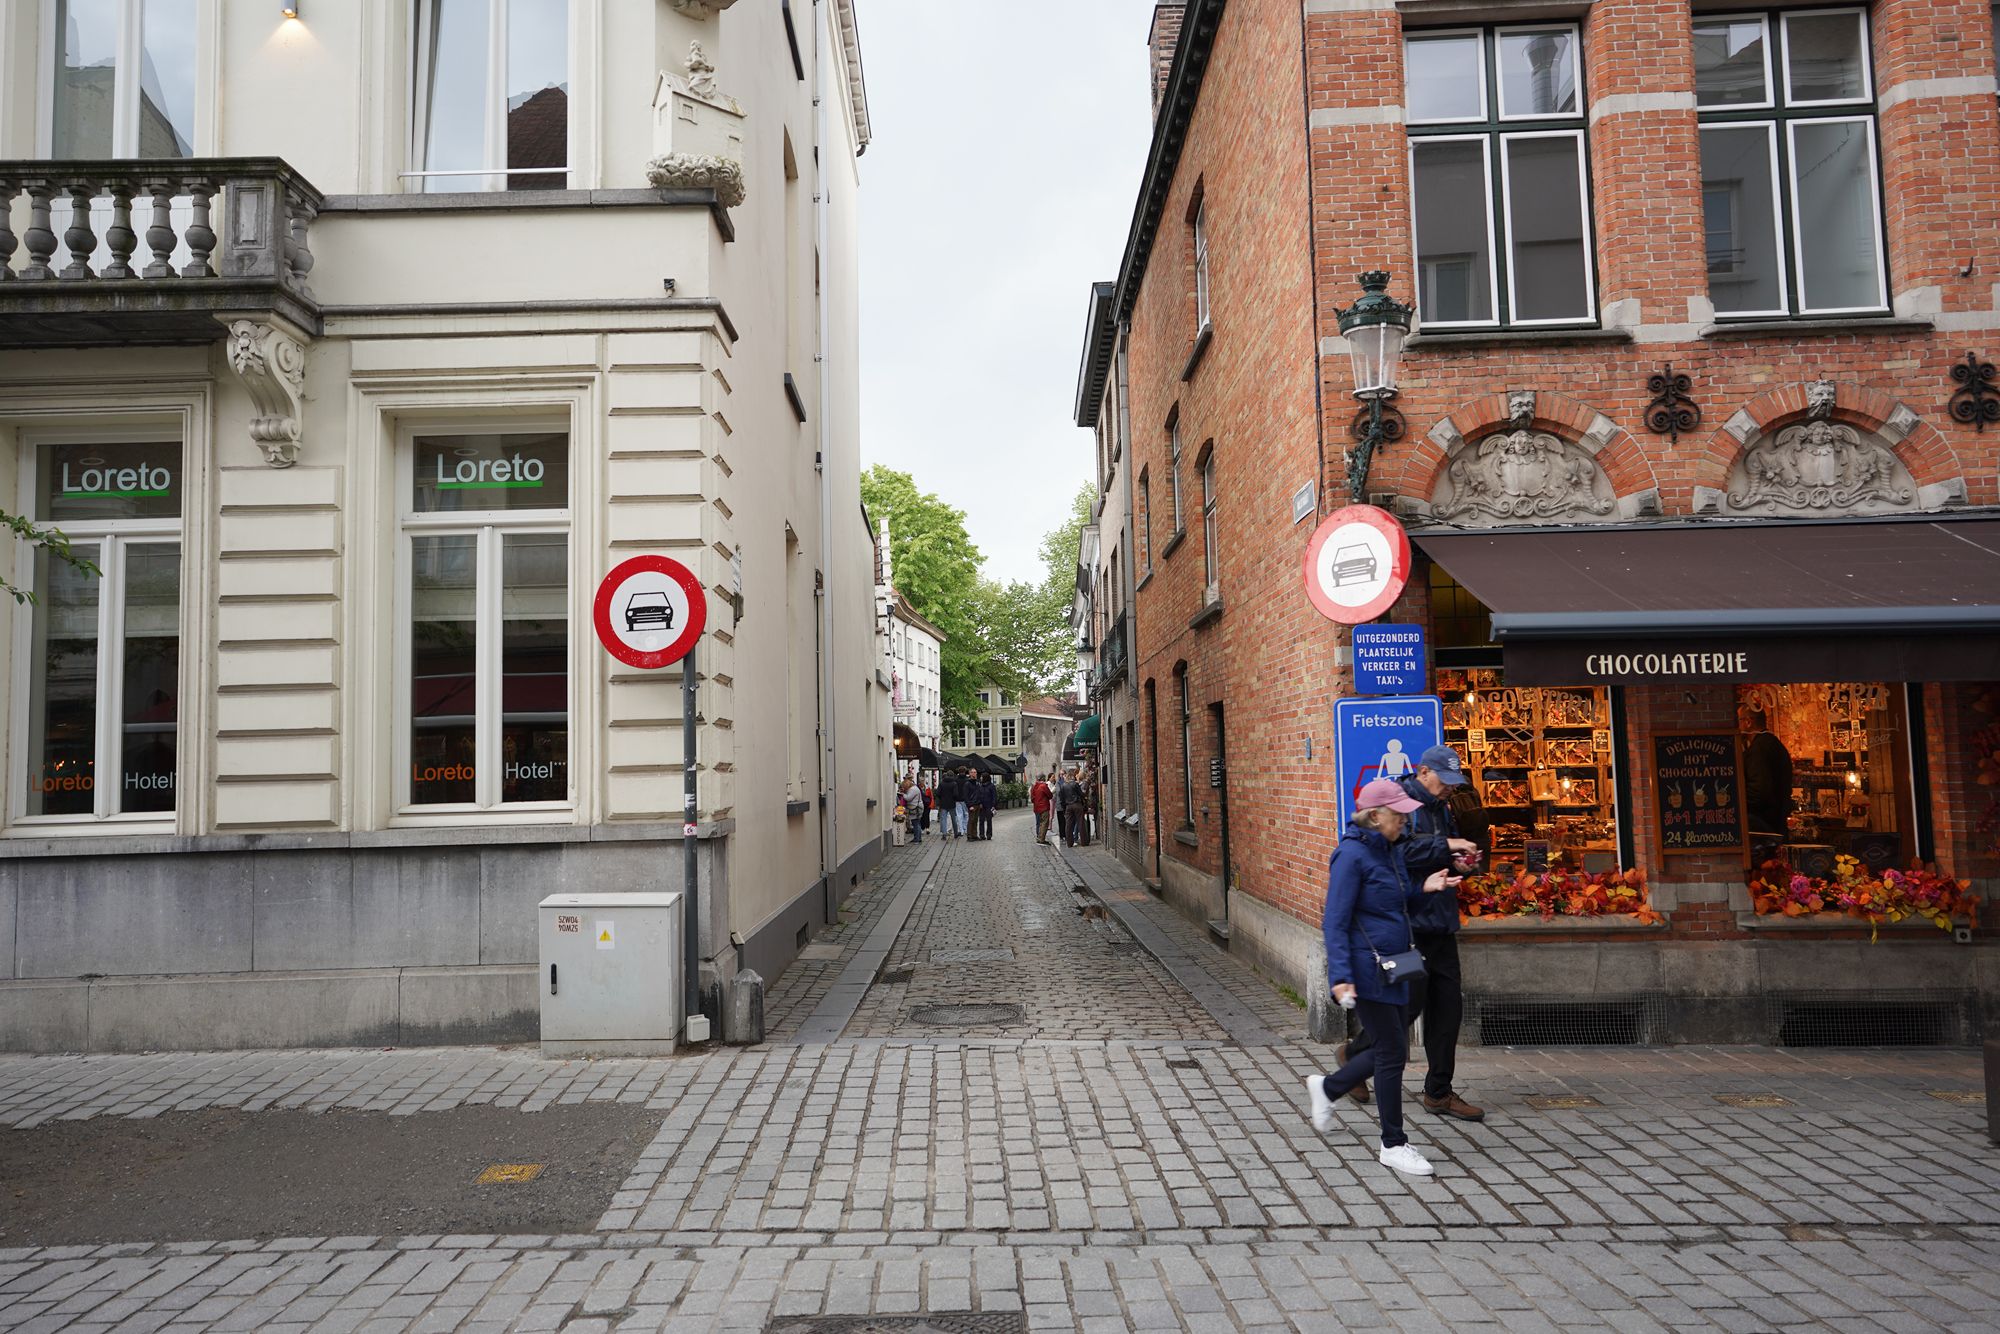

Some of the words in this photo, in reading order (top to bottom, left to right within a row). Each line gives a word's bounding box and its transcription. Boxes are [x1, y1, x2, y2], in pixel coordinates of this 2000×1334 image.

[437, 452, 545, 483] Loreto
[62, 461, 171, 492] Loreto
[1356, 633, 1420, 644] UITGEZONDERD
[1358, 647, 1414, 658] PLAATSELIJK
[1362, 661, 1400, 671] VERKEER
[1405, 661, 1416, 671] EN
[1586, 652, 1748, 676] CHOCOLATERIE
[1352, 714, 1424, 728] Fietszone
[1666, 739, 1726, 756] DELICIOUS
[1684, 754, 1709, 765] HOT
[413, 762, 475, 782] Loreto
[1659, 766, 1734, 779] CHOCOLATES
[31, 772, 94, 793] Loreto
[125, 771, 173, 790] Hotel
[1695, 808, 1736, 824] FREE
[1666, 831, 1682, 843] 24
[1684, 830, 1735, 846] flavours
